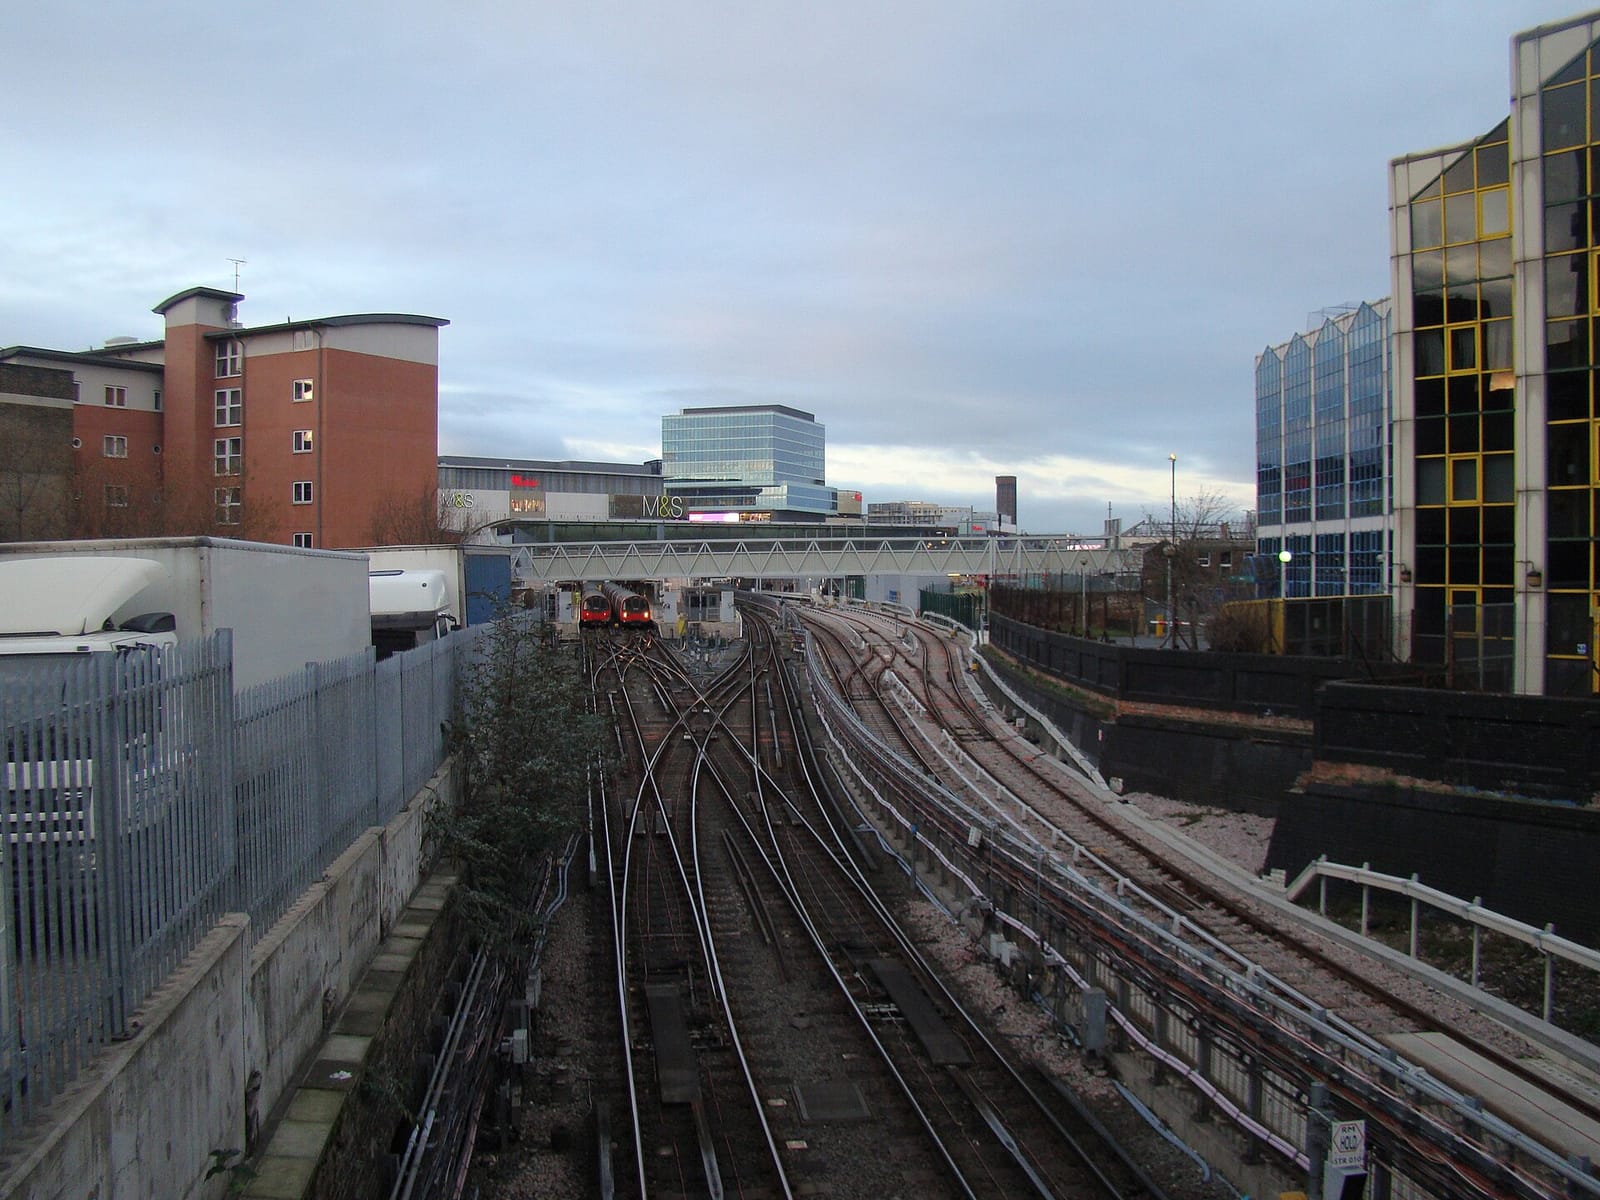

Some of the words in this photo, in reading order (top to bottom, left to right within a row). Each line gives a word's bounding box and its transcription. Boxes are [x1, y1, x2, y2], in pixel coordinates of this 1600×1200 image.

[442, 491, 474, 508] M&S
[642, 495, 683, 518] M&S
[1341, 1126, 1356, 1134] RM
[1339, 1135, 1358, 1150] HOLD
